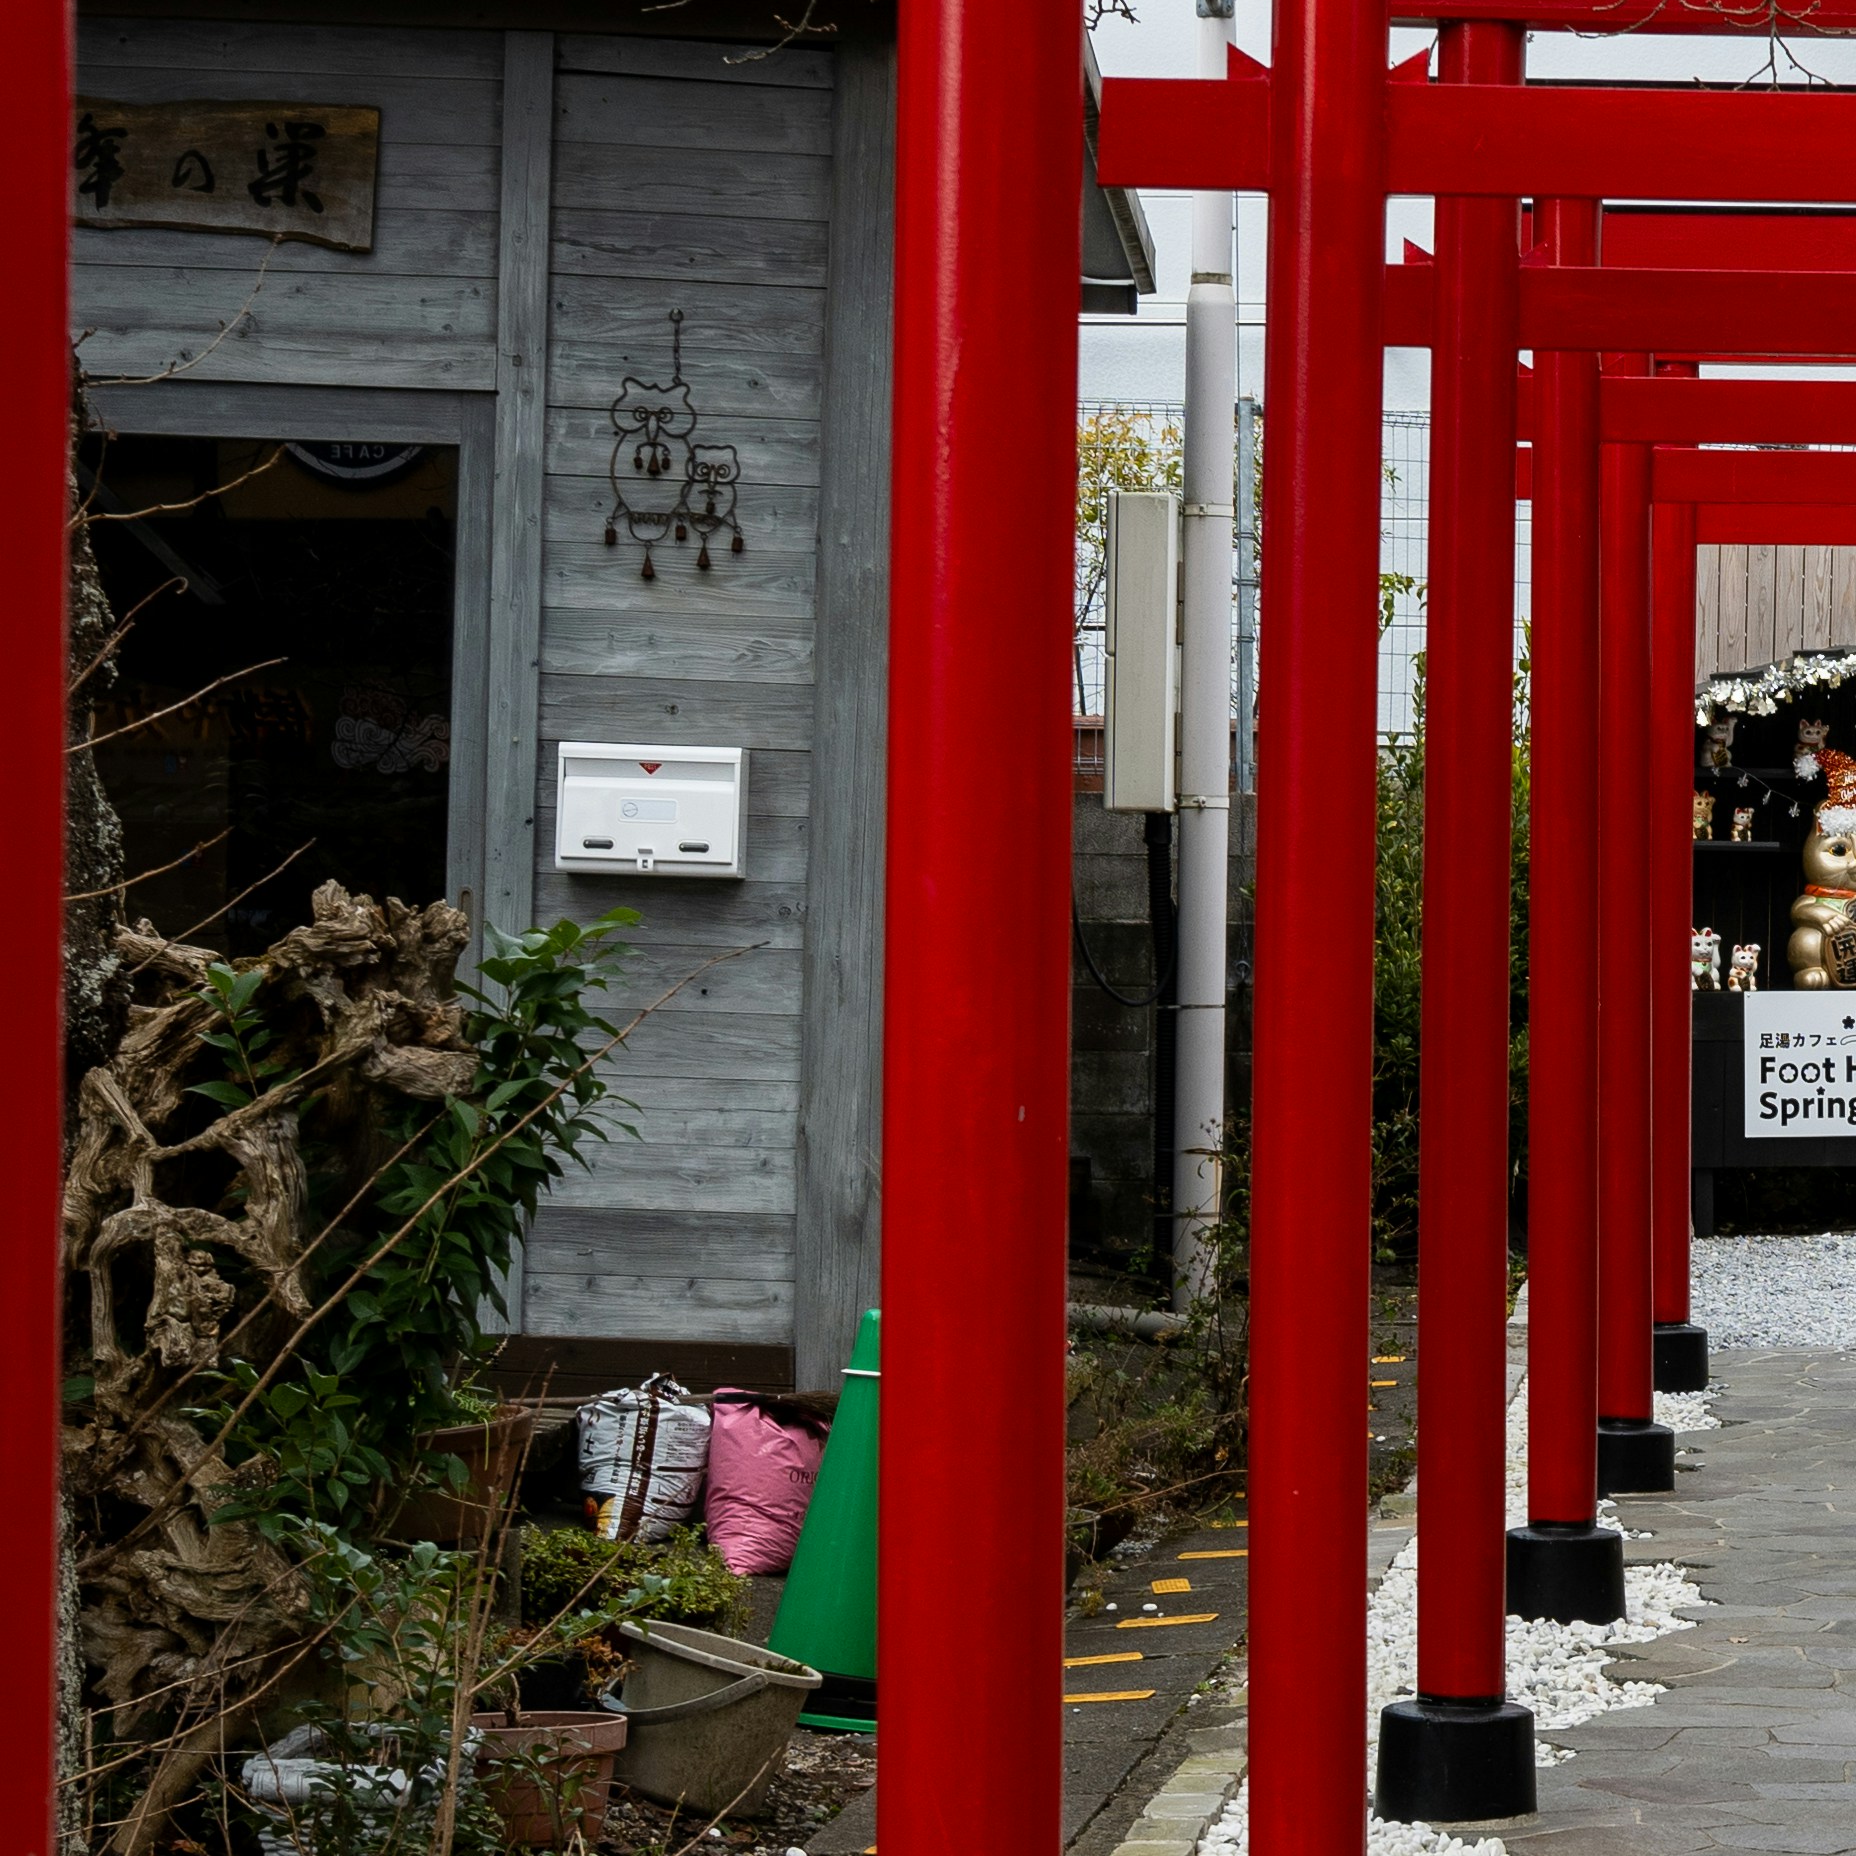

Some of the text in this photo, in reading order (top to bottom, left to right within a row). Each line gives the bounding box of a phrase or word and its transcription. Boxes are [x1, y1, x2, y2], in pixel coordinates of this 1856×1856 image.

[1759, 1033, 1837, 1049] 足湯カフェ
[1760, 1056, 1836, 1084] Foot
